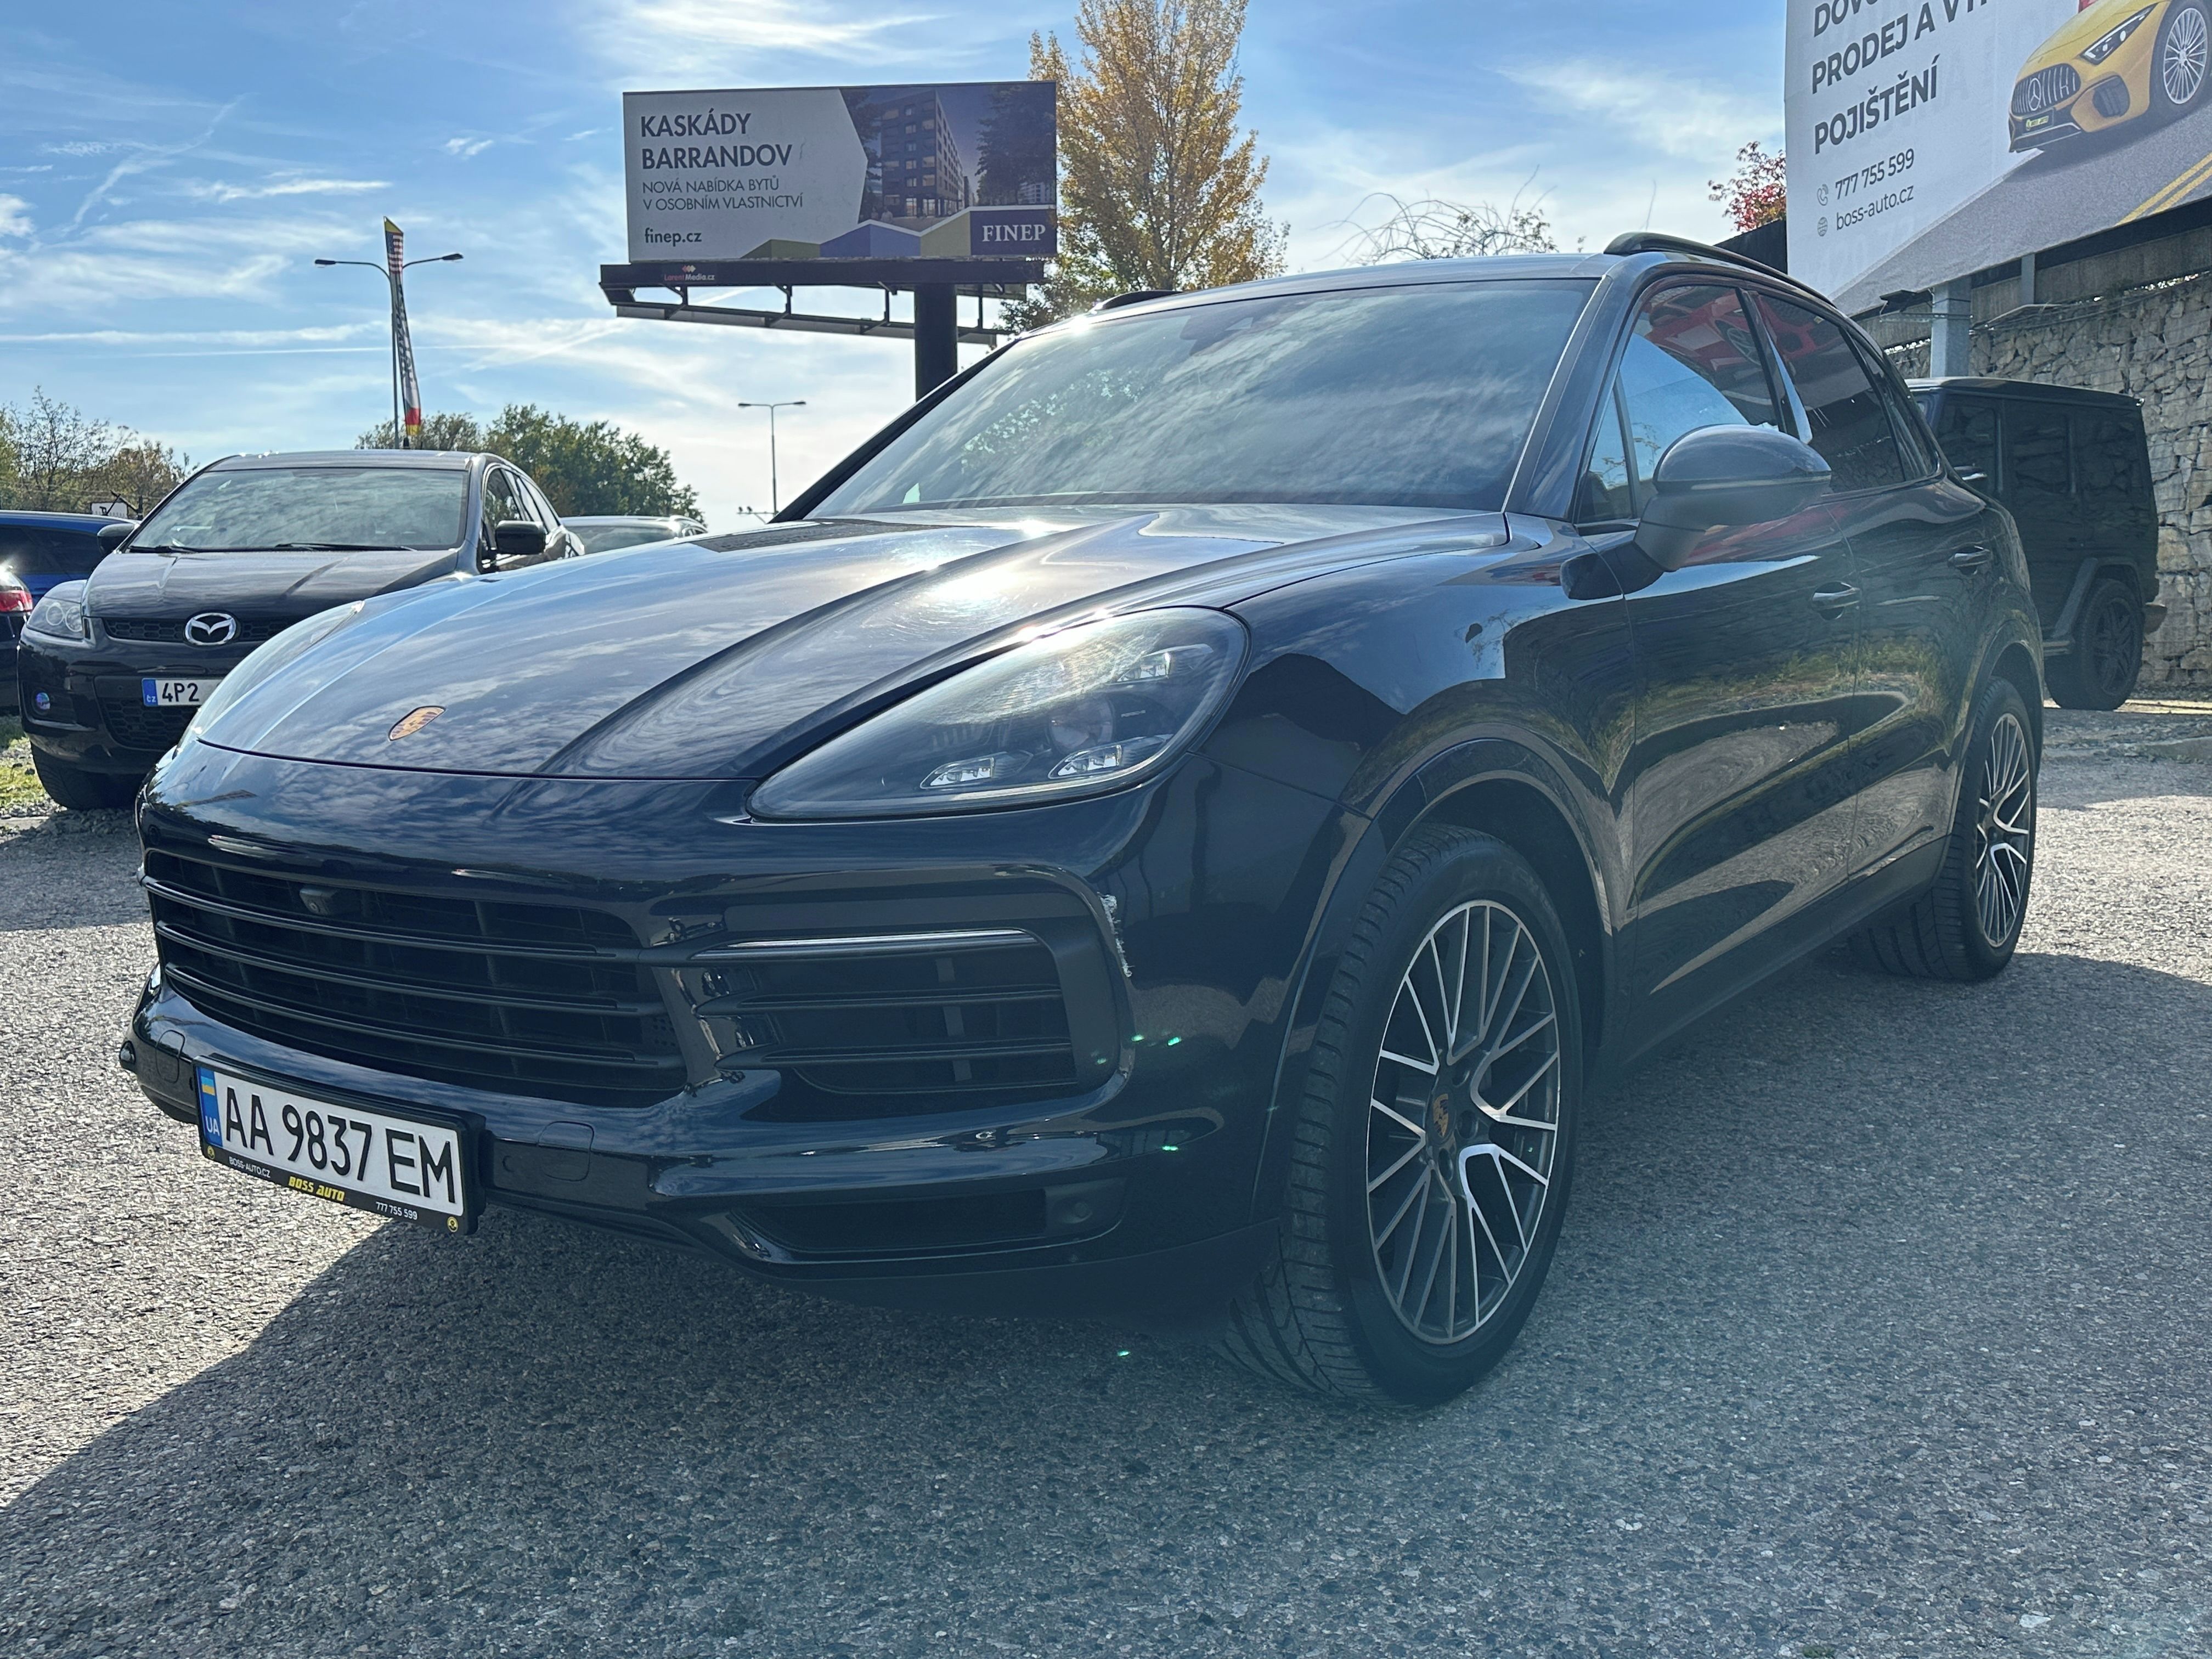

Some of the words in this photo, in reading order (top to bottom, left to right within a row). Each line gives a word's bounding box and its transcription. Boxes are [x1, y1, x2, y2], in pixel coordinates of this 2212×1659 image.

[1812, 13, 1908, 94] PRODEJ
[1915, 2, 1936, 41] A
[1815, 54, 1940, 155] POJIŠTĚNÍ
[641, 108, 752, 137] KASKÁDY
[642, 144, 793, 170] BARRANDOV
[642, 177, 682, 193] NOVÁ
[686, 177, 744, 193] NABÍDKA
[748, 175, 779, 191] BYTŮ
[1835, 173, 1858, 200] 777
[1861, 161, 1884, 188] 755
[1888, 148, 1914, 176] 599
[643, 199, 652, 210] V
[656, 195, 720, 211] OSOBNÍM
[723, 192, 804, 208] VLASTNICTVÍ
[1836, 185, 1914, 230] boss-auto.cz
[645, 227, 702, 246] finep.cz
[982, 224, 1046, 241] FINEP
[162, 682, 199, 702] 4P2
[205, 1115, 220, 1136] UA
[226, 1087, 274, 1155] AA
[282, 1104, 372, 1181] 9837
[386, 1128, 455, 1203] EM
[229, 1156, 270, 1178] BOSS-AUTO.CZ
[288, 1176, 314, 1193] BOSS
[316, 1184, 345, 1201] AUTO
[375, 1201, 387, 1212] 777
[388, 1205, 402, 1216] 755
[404, 1209, 417, 1220] 599
